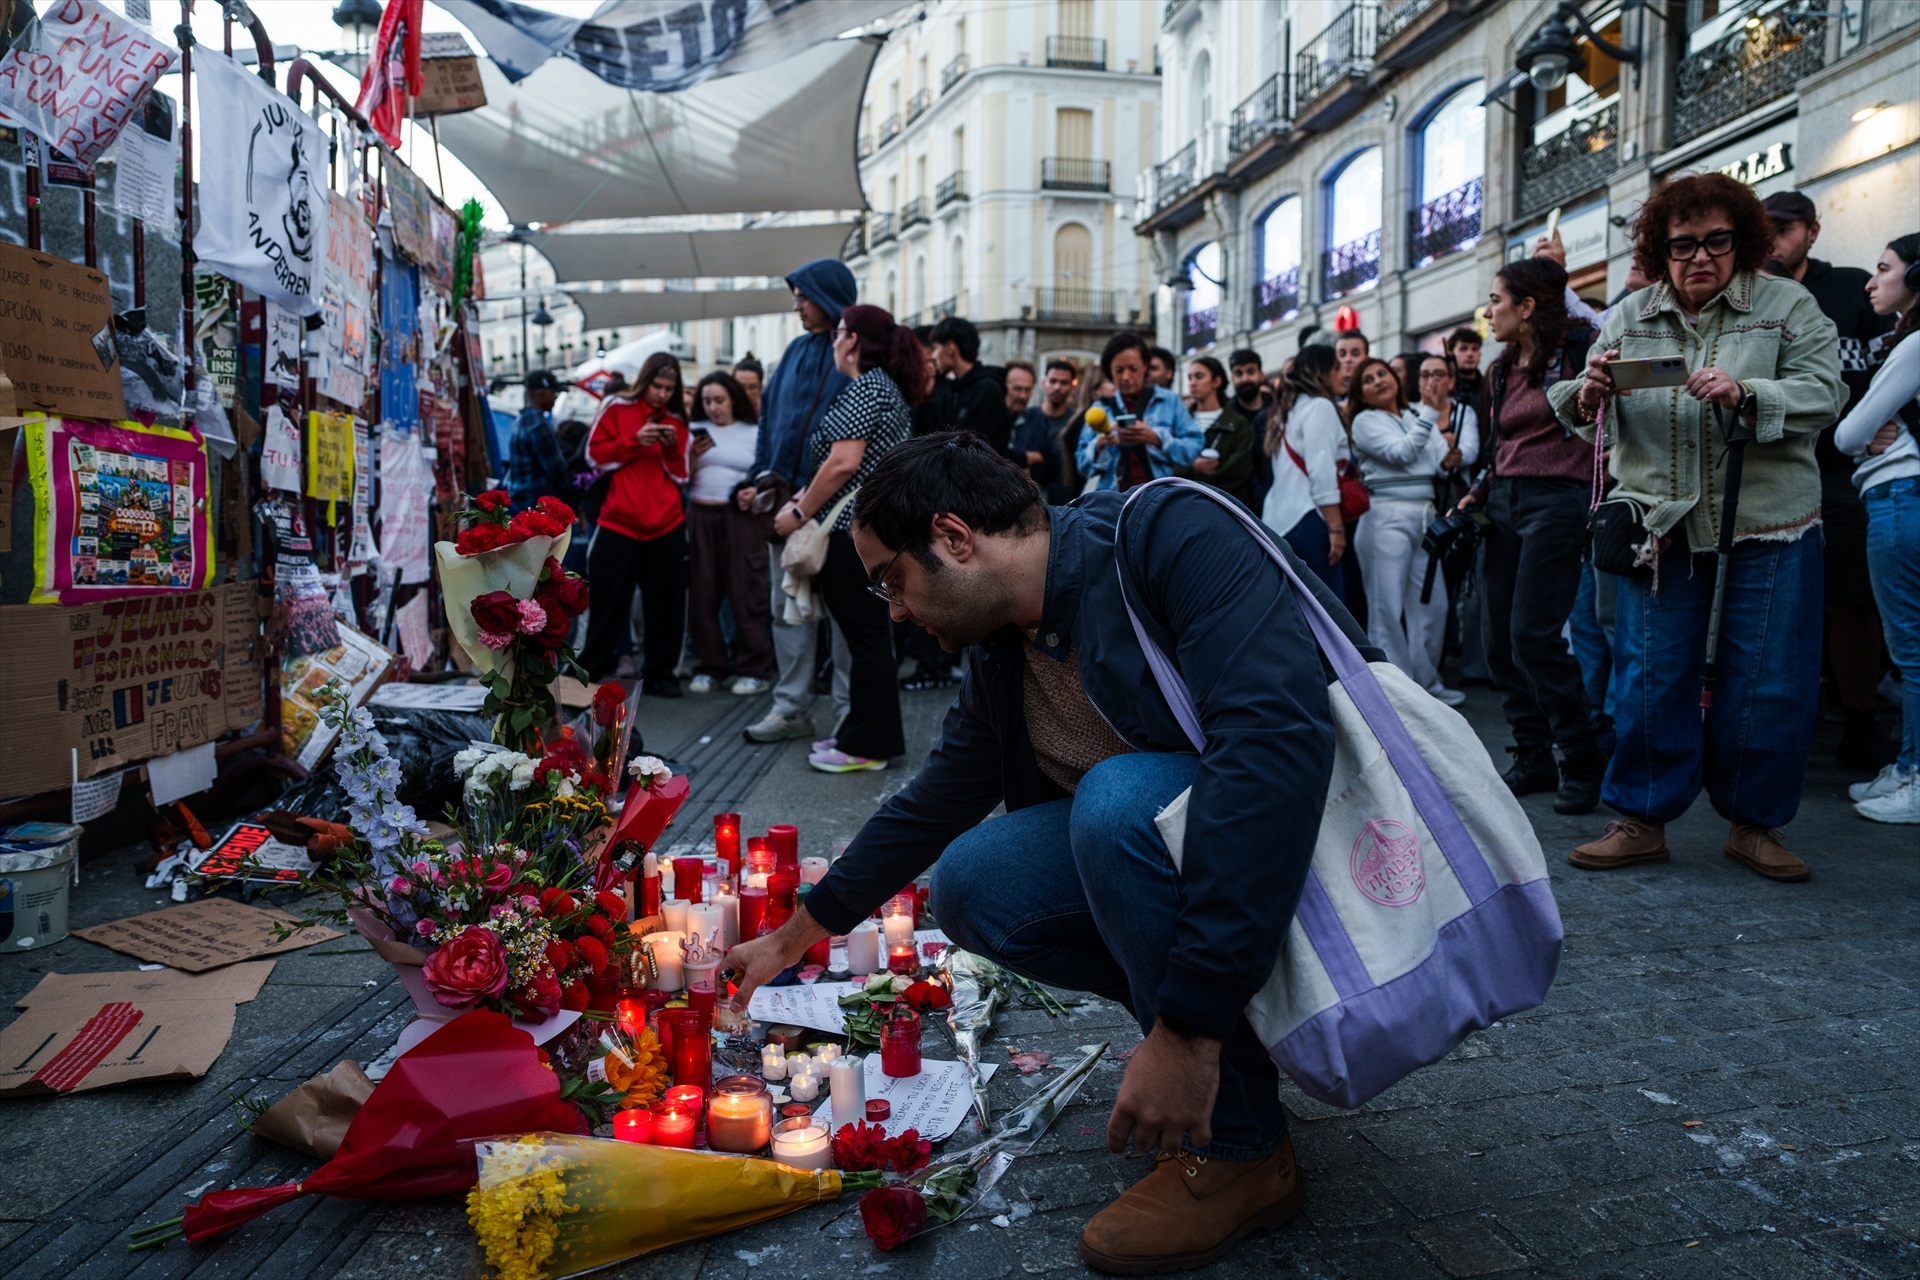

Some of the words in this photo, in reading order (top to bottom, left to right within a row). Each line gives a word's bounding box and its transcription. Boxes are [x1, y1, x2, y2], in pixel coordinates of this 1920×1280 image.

[40, 278, 53, 291] NO
[57, 282, 69, 297] SE
[51, 316, 67, 329] SINO
[73, 321, 95, 334] COMO
[37, 354, 55, 366] PARA
[213, 349, 232, 359] POR
[31, 383, 41, 393] DE
[70, 612, 90, 631] LES
[96, 592, 216, 649] JEUNES
[94, 638, 213, 683] ESPAGNOLS
[147, 668, 222, 707] JEUNES
[0, 1069, 38, 1077] ARRIB
[907, 1091, 919, 1100] TU
[941, 1081, 964, 1105] MUERTE
[918, 1102, 931, 1111] POR
